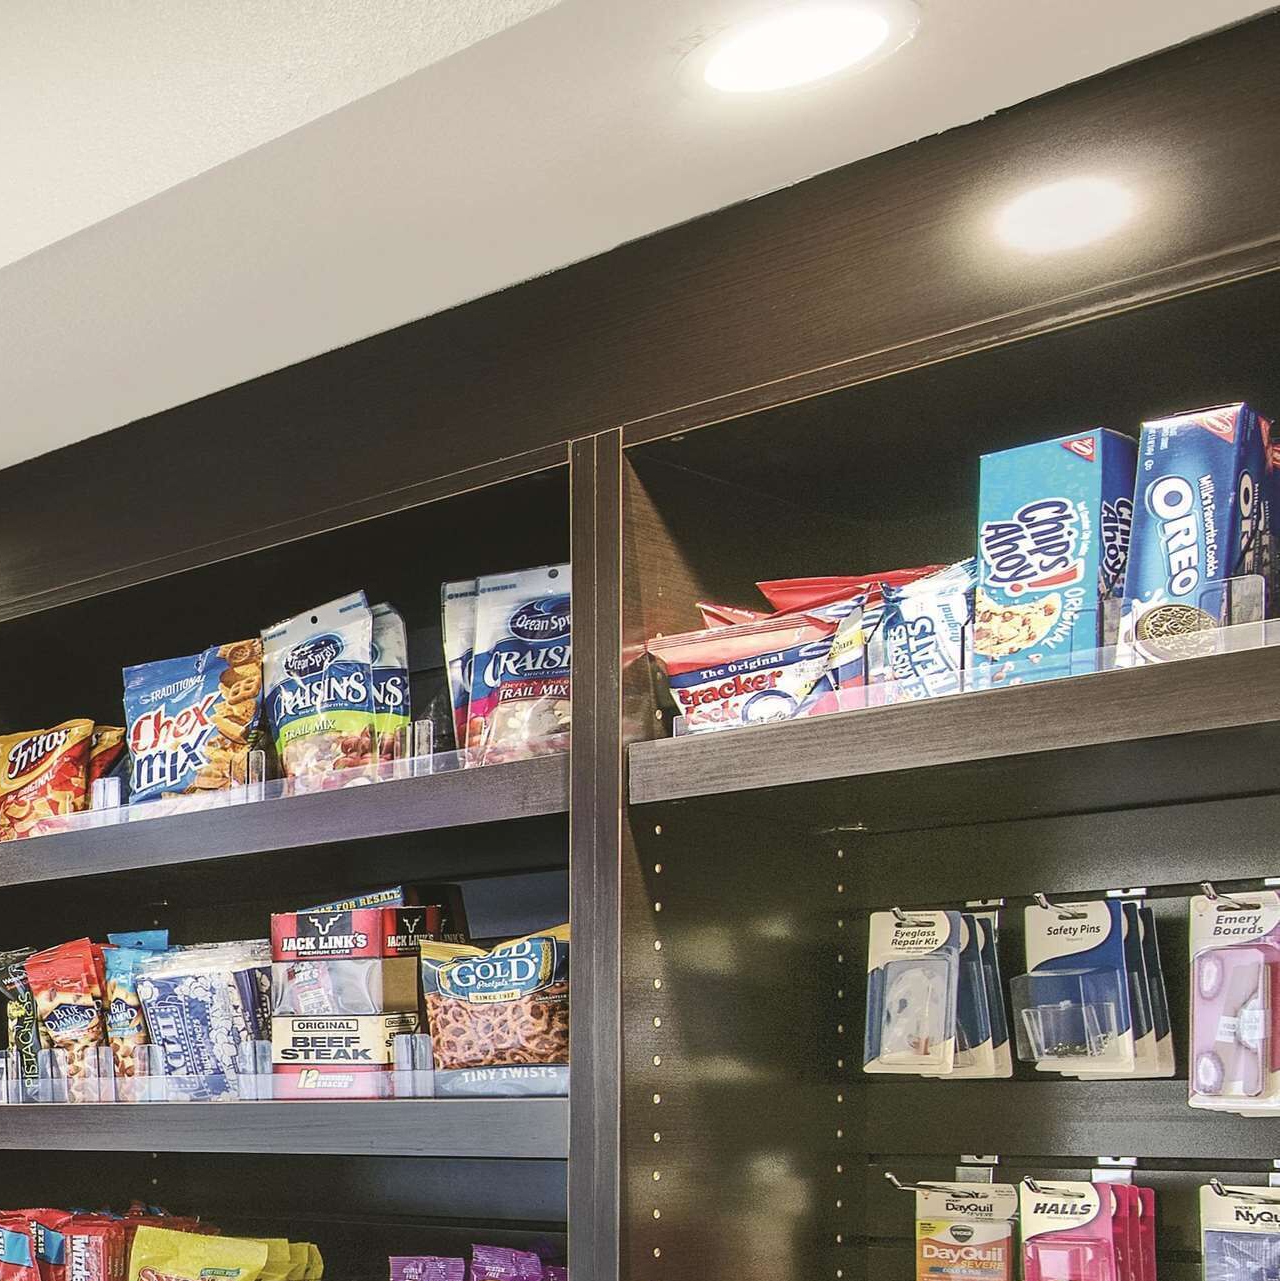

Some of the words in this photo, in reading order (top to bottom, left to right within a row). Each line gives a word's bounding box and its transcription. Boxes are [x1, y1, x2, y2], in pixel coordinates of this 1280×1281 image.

[1018, 500, 1068, 574] Chips
[1151, 477, 1200, 596] OREO
[516, 614, 547, 631] Ocean
[308, 644, 336, 666] Spray
[700, 668, 725, 680] The
[728, 653, 784, 673] Original
[151, 675, 205, 703] TRADITIONAL
[499, 688, 535, 701] TRAIL
[539, 683, 569, 697] MIX
[678, 669, 783, 706] Cracker
[132, 692, 220, 753] Chex
[286, 728, 309, 741] TRAIL
[313, 720, 335, 734] MIX
[8, 729, 69, 779] Fritos
[135, 729, 207, 792] mix
[359, 890, 401, 908] RESALE
[1215, 914, 1262, 926] Emery
[894, 929, 936, 939] Eyeglass
[1046, 925, 1078, 936] Safety
[1079, 924, 1101, 935] Pins
[1212, 924, 1265, 936] Boards
[281, 936, 316, 952] JACK
[318, 933, 368, 950] LINK'S
[387, 935, 407, 947] JACK
[891, 939, 923, 947] Repair
[924, 937, 938, 945] Kit
[298, 949, 332, 957] PREMIUM
[450, 958, 537, 988] GOLD
[45, 1010, 97, 1031] DIAMOND
[55, 1005, 79, 1020] BLUE
[297, 1020, 353, 1030] ORIGINAL
[21, 990, 38, 1088] PISTACHIOS
[291, 1036, 361, 1048] BEEF
[280, 1048, 372, 1060] STEAK
[461, 1070, 496, 1084] TINY
[498, 1067, 558, 1081] TWISTS
[945, 1202, 993, 1215] DayQuil
[1033, 1202, 1093, 1216] HALLS
[922, 1243, 1003, 1264] DayQuil
[960, 1259, 1004, 1271] SEVERE
